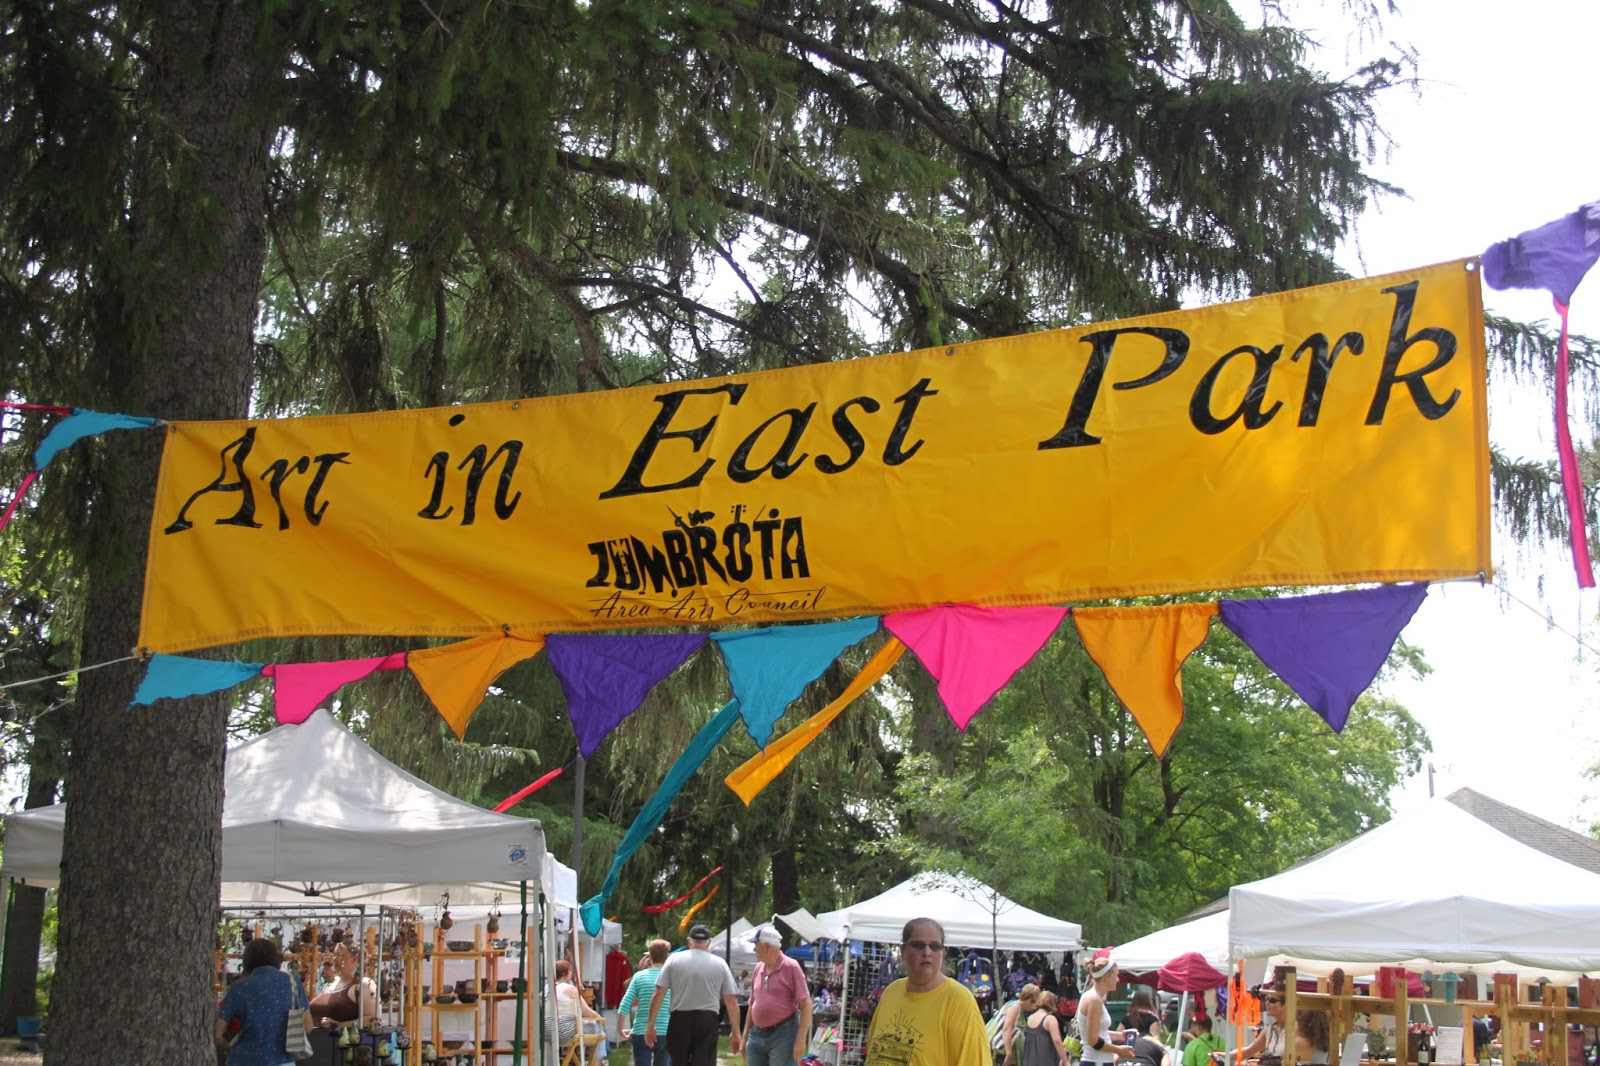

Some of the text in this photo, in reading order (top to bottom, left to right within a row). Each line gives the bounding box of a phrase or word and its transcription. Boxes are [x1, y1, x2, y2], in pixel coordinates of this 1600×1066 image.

[164, 280, 1462, 536] Art in East Park
[586, 505, 811, 597] ZUMBROTA
[588, 586, 827, 620] Area Arts Council
